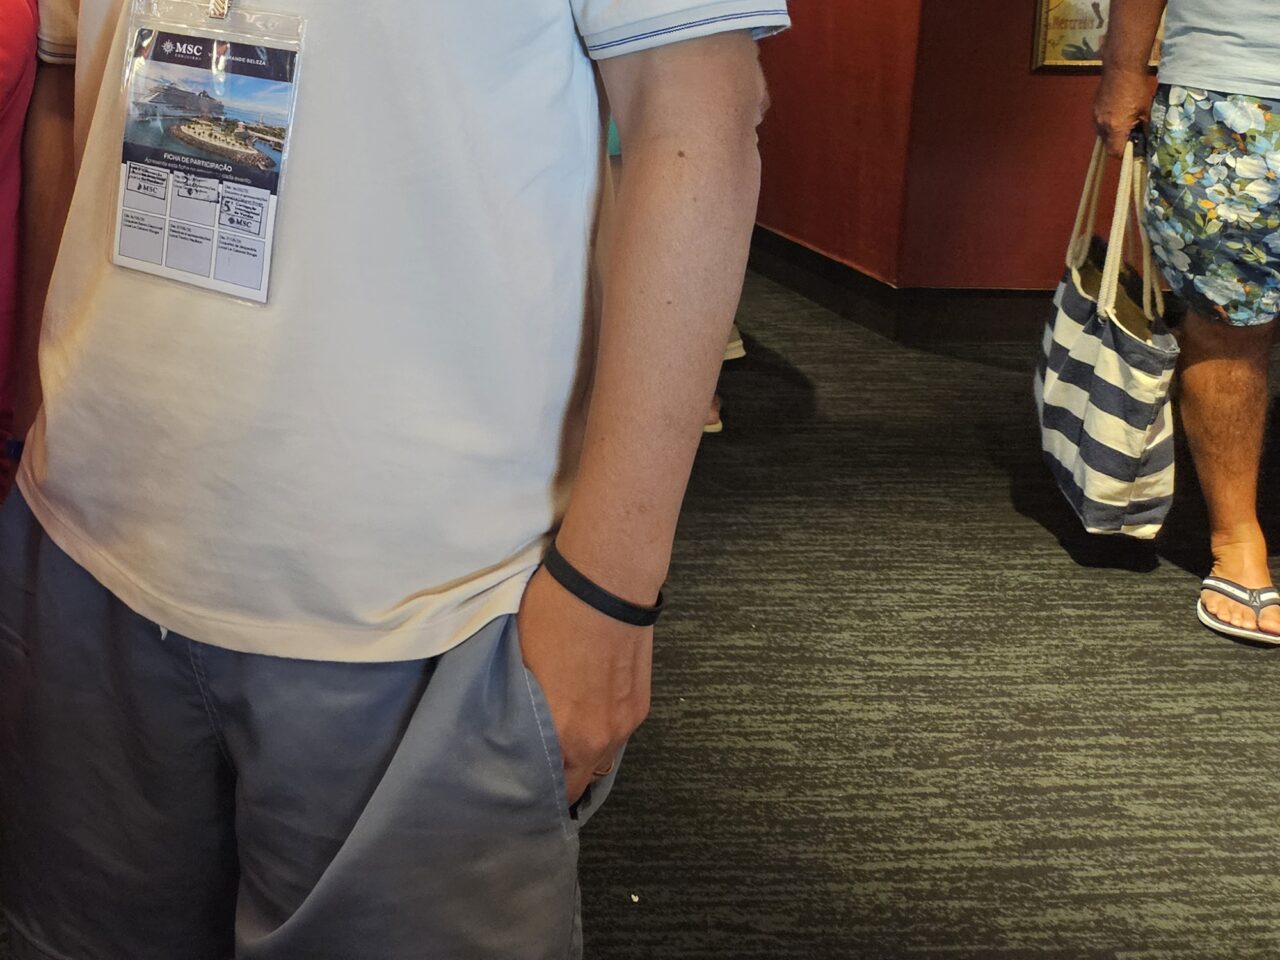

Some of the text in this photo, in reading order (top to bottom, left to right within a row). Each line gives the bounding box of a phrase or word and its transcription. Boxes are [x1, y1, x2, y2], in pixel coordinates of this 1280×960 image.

[175, 42, 203, 56] MSC
[163, 152, 181, 161] FICHA
[181, 155, 190, 163] DE
[143, 184, 158, 193] MSC
[236, 219, 252, 228] MSC
